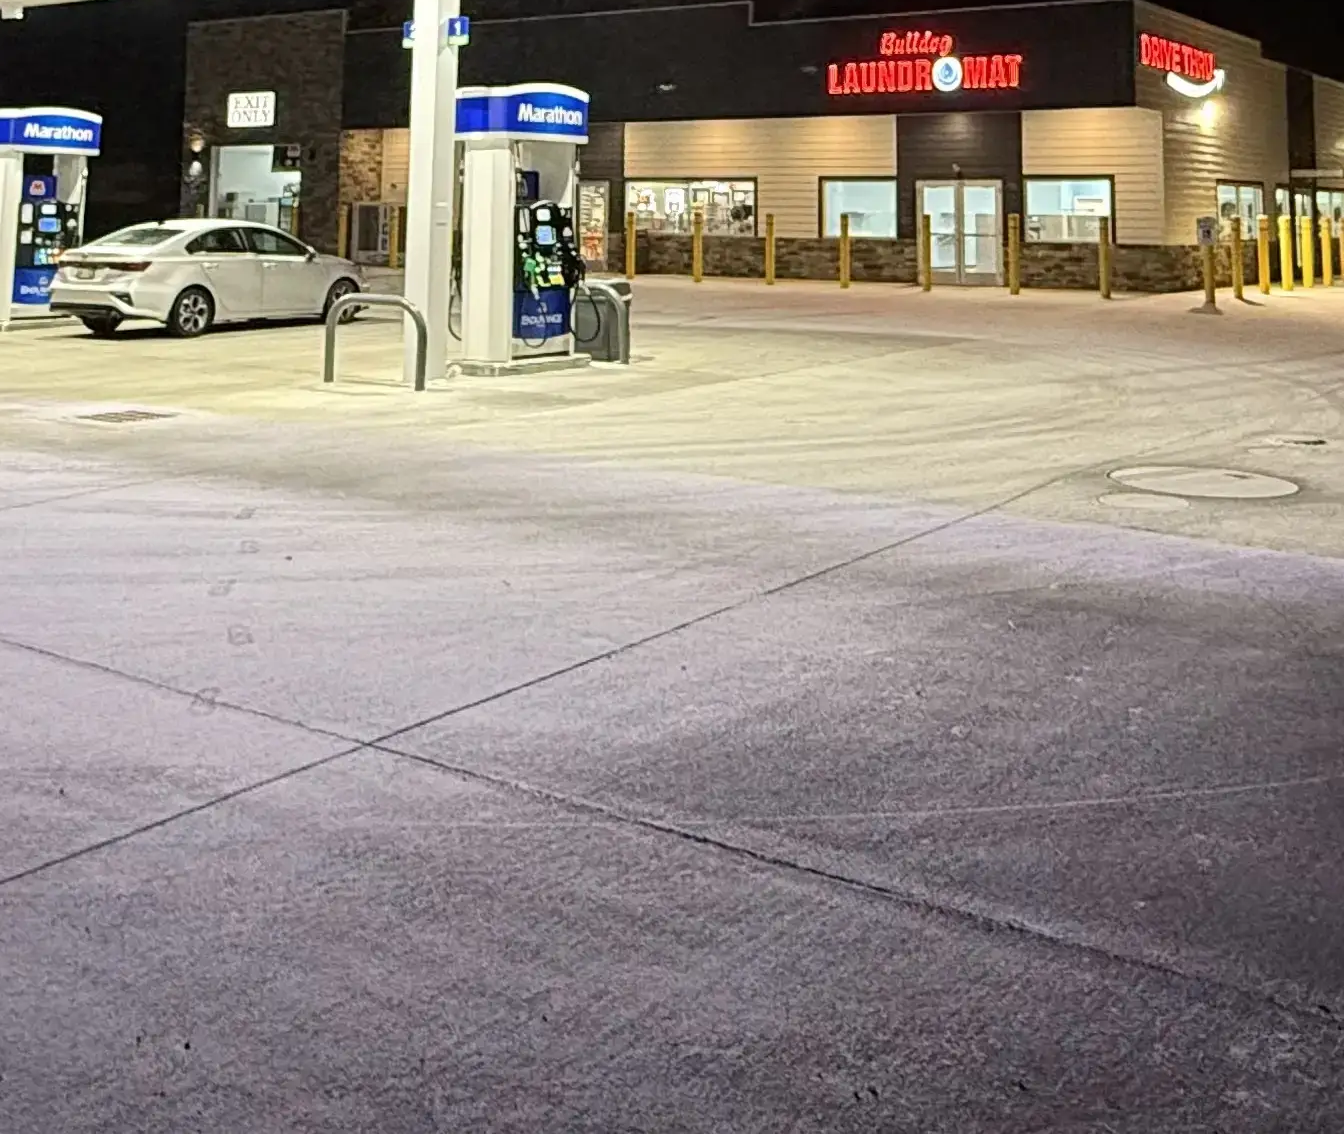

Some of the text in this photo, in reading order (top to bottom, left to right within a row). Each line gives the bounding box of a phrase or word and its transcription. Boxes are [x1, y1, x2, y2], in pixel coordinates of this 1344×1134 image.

[454, 20, 461, 36] 1
[879, 30, 953, 57] Bulldog
[1140, 33, 1214, 81] DRIVE THRU
[234, 95, 270, 109] EXIT
[231, 109, 272, 123] ONLY
[517, 102, 583, 126] Marathon
[23, 122, 94, 142] Marathon
